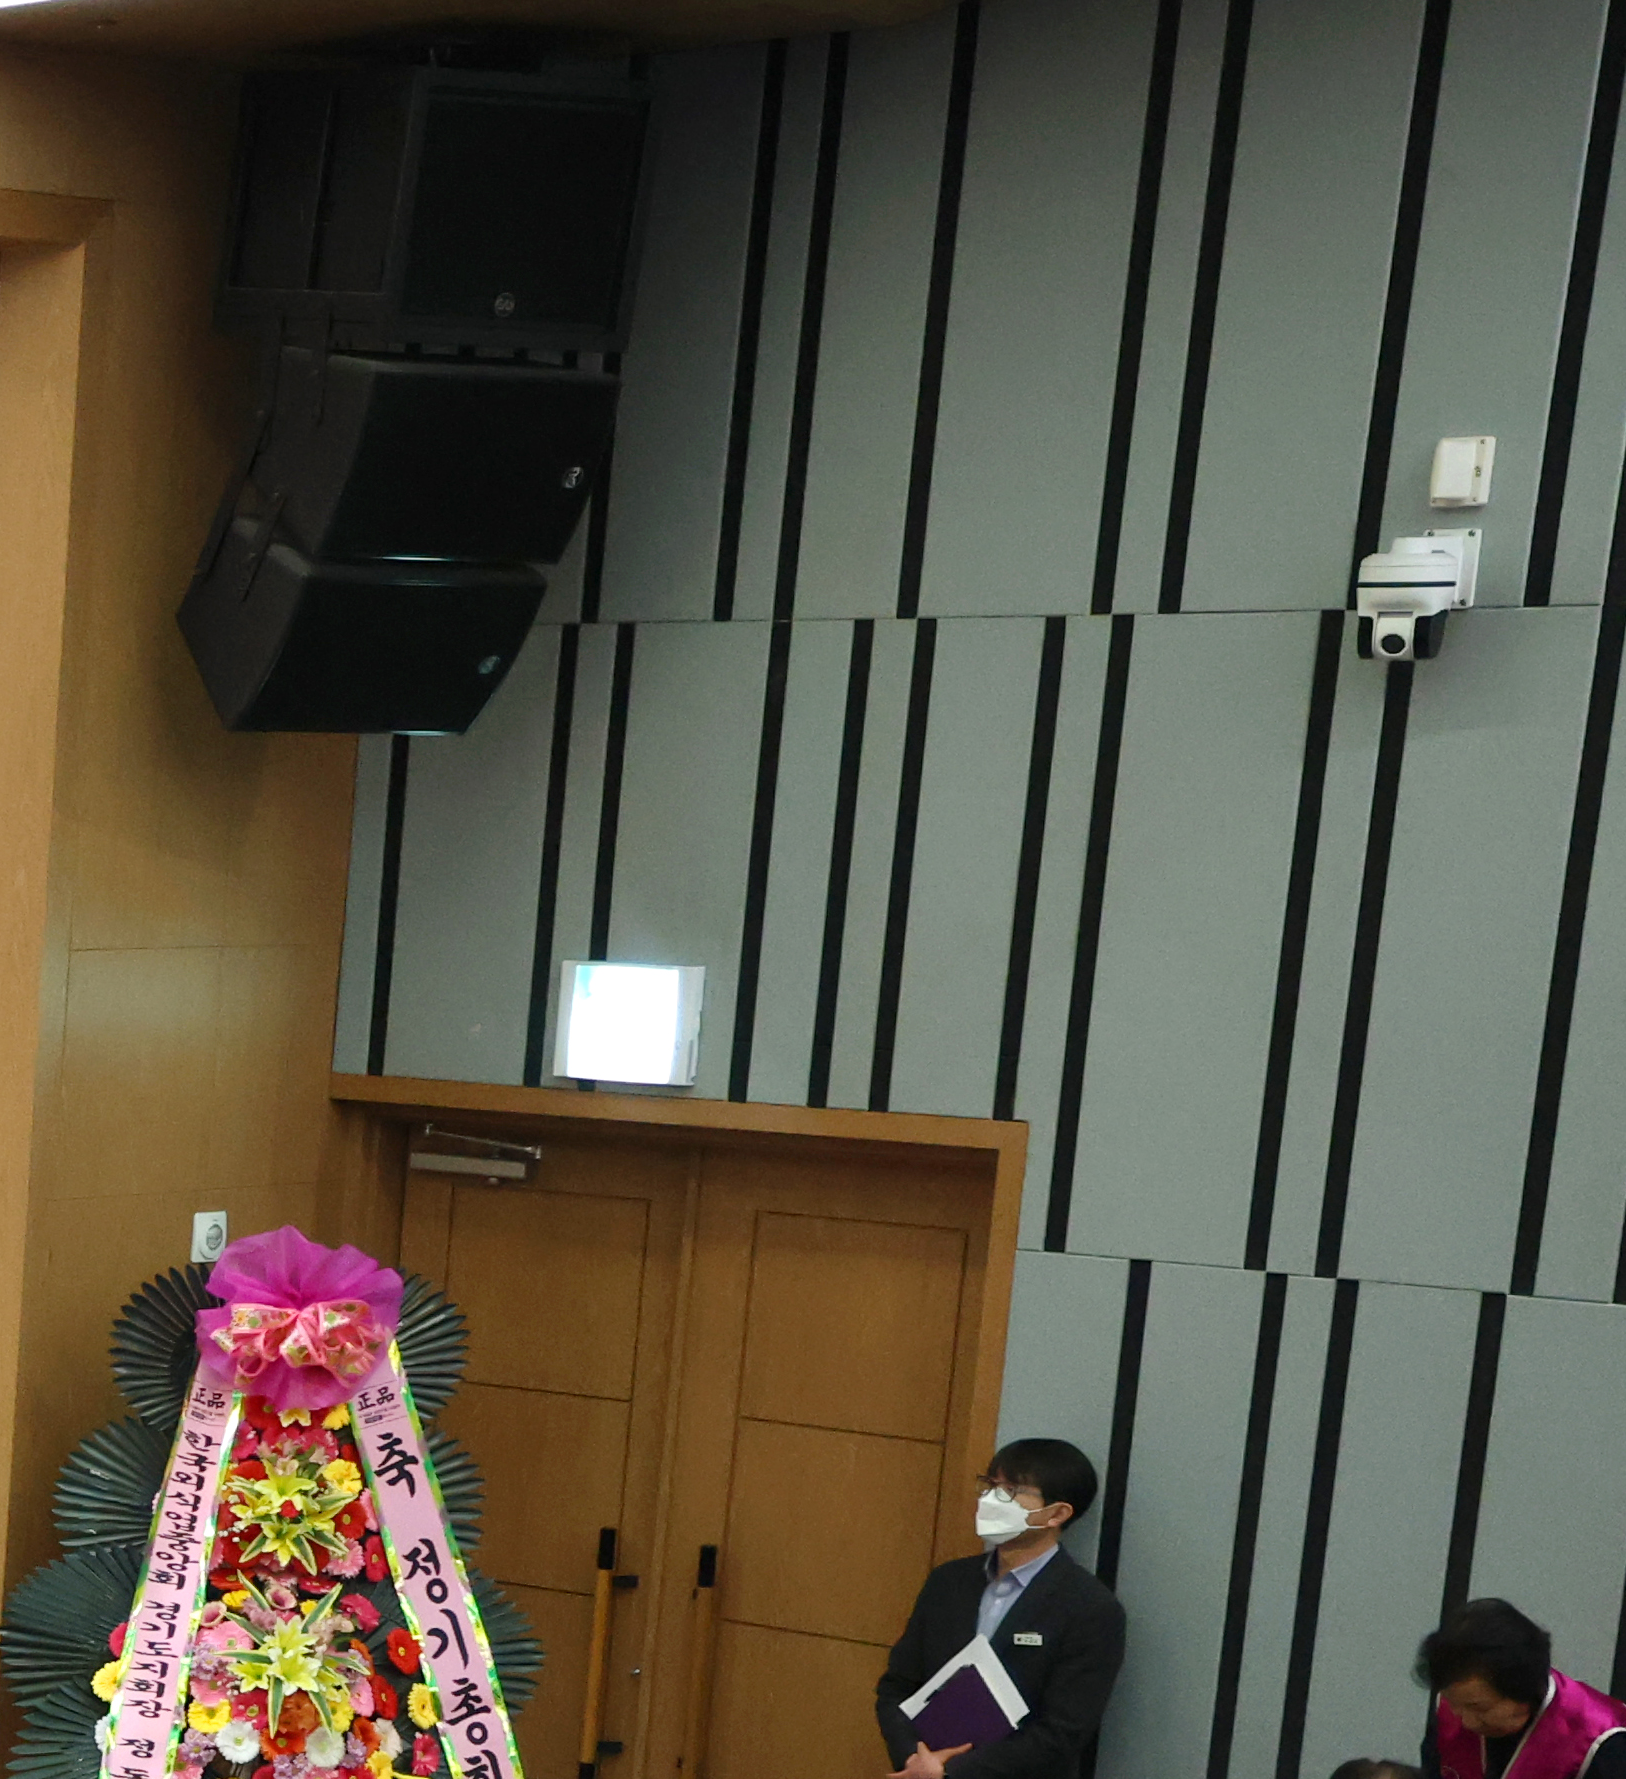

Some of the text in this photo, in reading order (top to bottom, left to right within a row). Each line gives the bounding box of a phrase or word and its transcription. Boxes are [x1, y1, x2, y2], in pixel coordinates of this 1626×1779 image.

[357, 1385, 395, 1412] 正品
[373, 1431, 419, 1498] 축
[148, 1429, 222, 1591] 한국외식업중앙회
